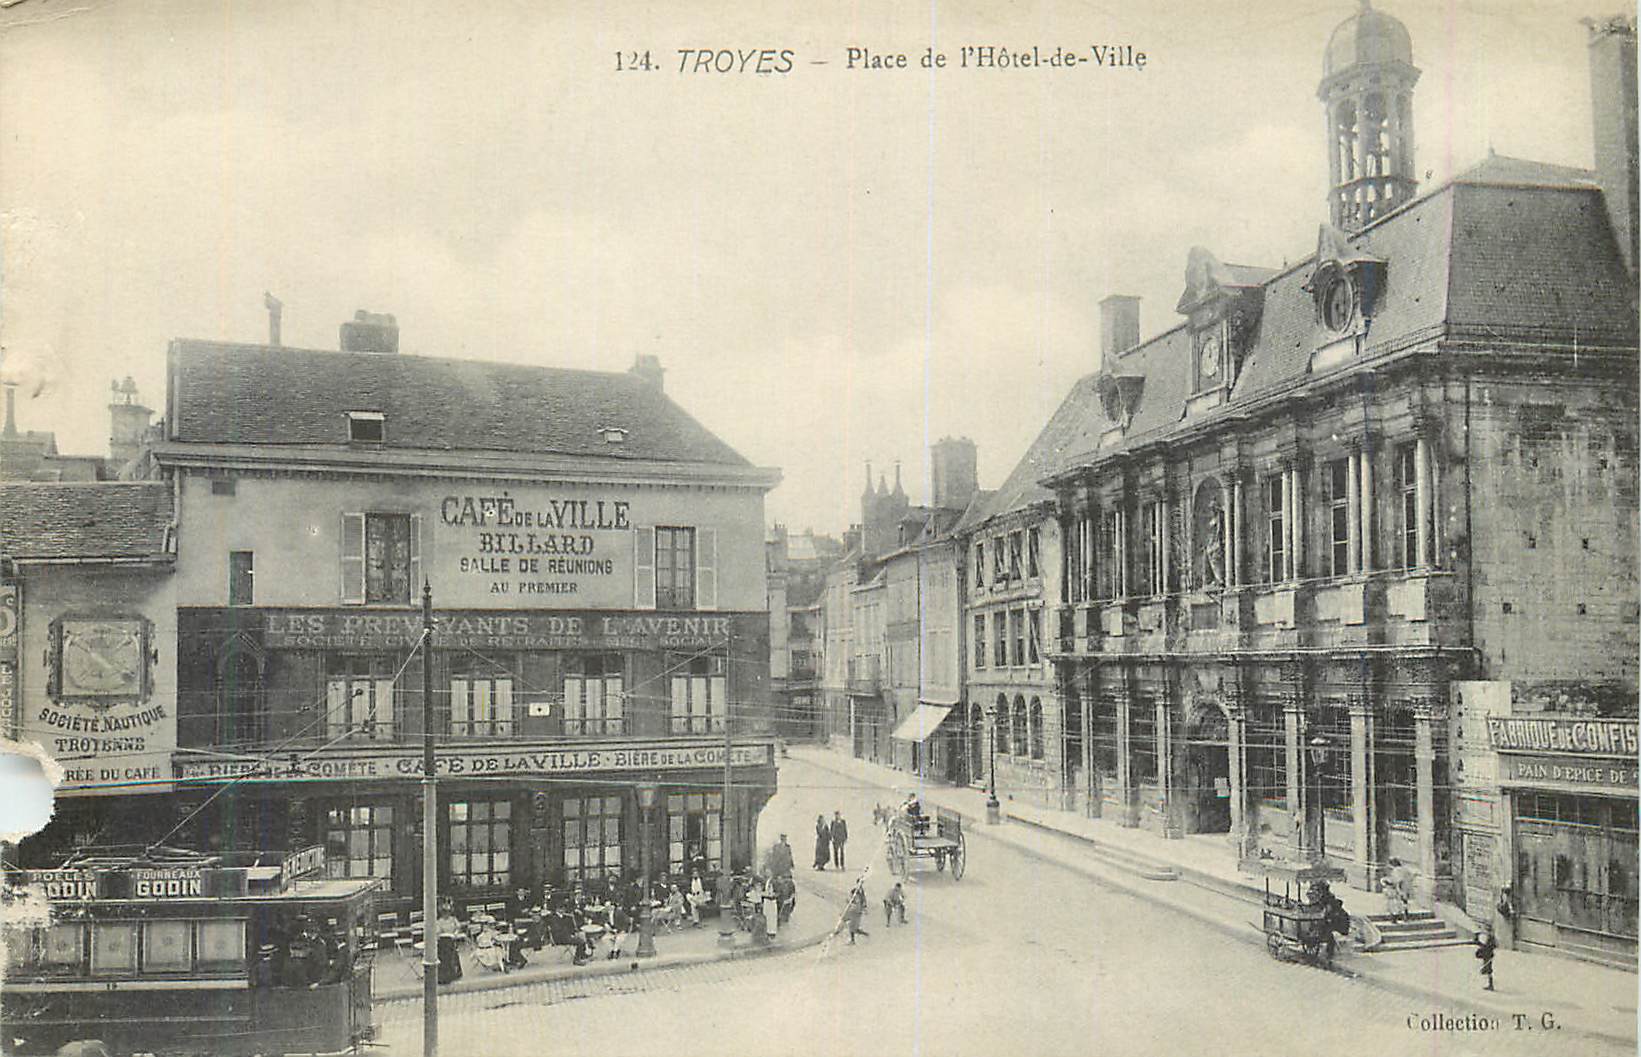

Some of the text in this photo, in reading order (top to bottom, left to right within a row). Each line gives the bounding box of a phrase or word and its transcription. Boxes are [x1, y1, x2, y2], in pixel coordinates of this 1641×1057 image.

[441, 491, 631, 530] CAFÉ DE LA VILLE
[479, 532, 595, 556] BILLARD
[460, 555, 614, 575] SALLE DE RÉUNIONS
[490, 581, 578, 593] AU PREMIER
[266, 615, 729, 636] LES PREVYANTS DE L'AVENIR
[39, 705, 167, 733] SOCIÉTÉ NAUTIQUE
[1488, 719, 1557, 749] FABRIQUE
[472, 757, 499, 772] DE
[504, 756, 530, 771] LA
[528, 751, 601, 770] VILLE
[661, 754, 674, 765] DE
[677, 753, 692, 764] LA
[101, 769, 120, 780] DU
[1518, 763, 1548, 778] PAIN
[1609, 769, 1628, 785] DE
[136, 869, 202, 880] FOURNEAUX
[38, 881, 97, 899] ODIN
[136, 880, 202, 897] GODIN
